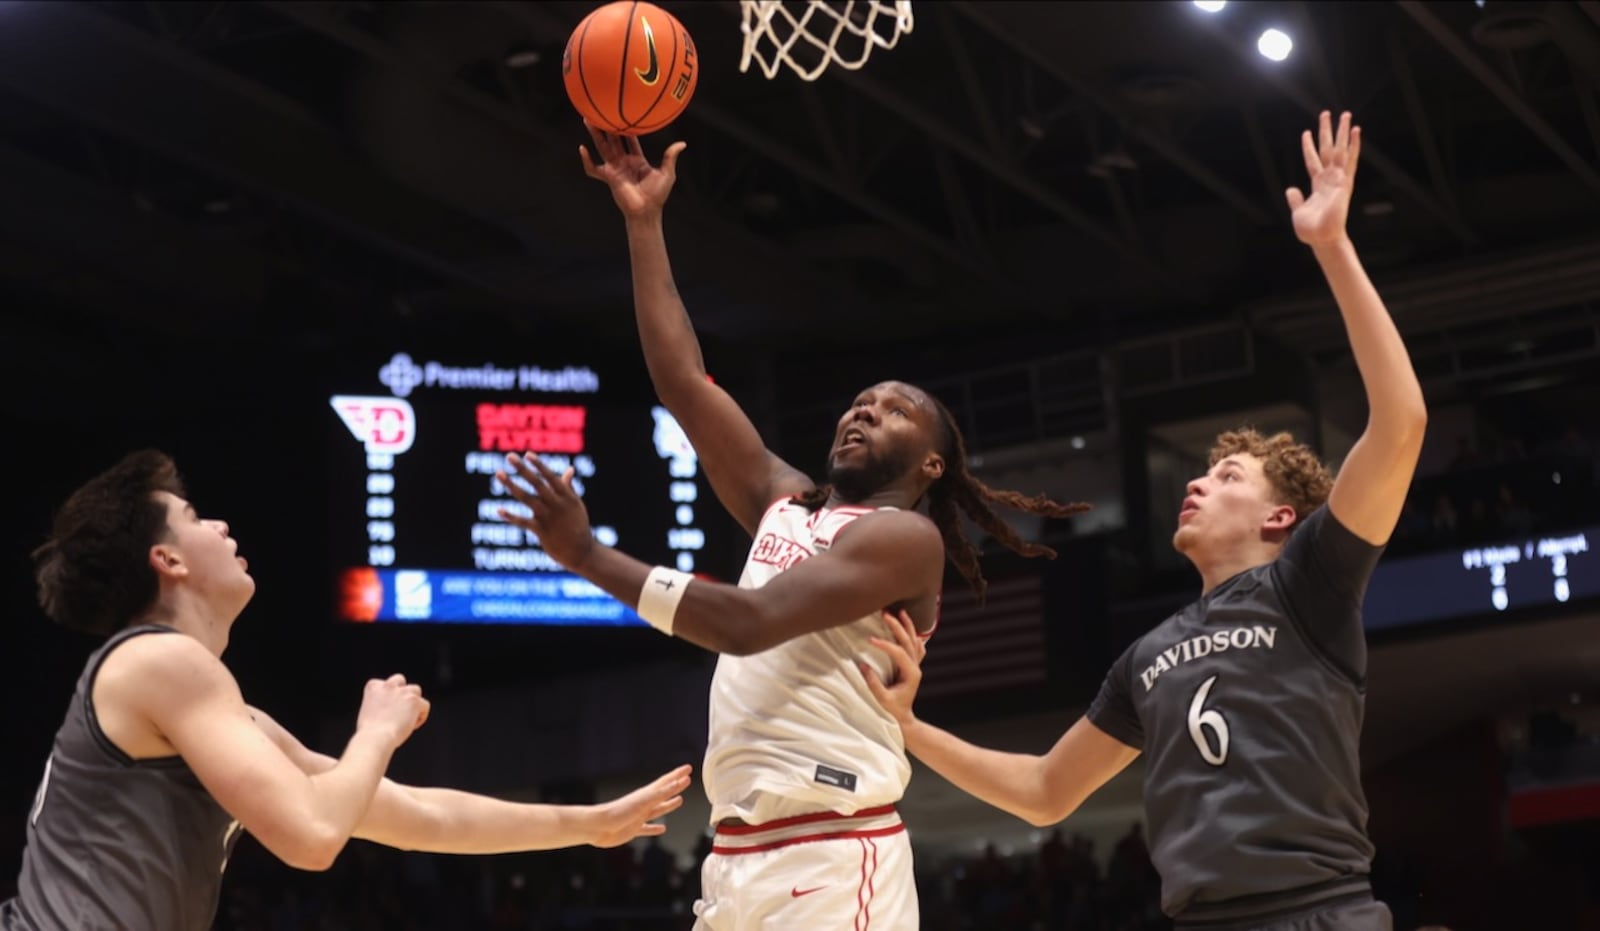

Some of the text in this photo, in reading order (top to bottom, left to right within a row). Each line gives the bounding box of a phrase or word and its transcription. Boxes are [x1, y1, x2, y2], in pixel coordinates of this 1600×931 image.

[424, 362, 600, 393] Premier Health
[1140, 625, 1278, 692] DAVIDSON
[1187, 675, 1230, 766] 6
